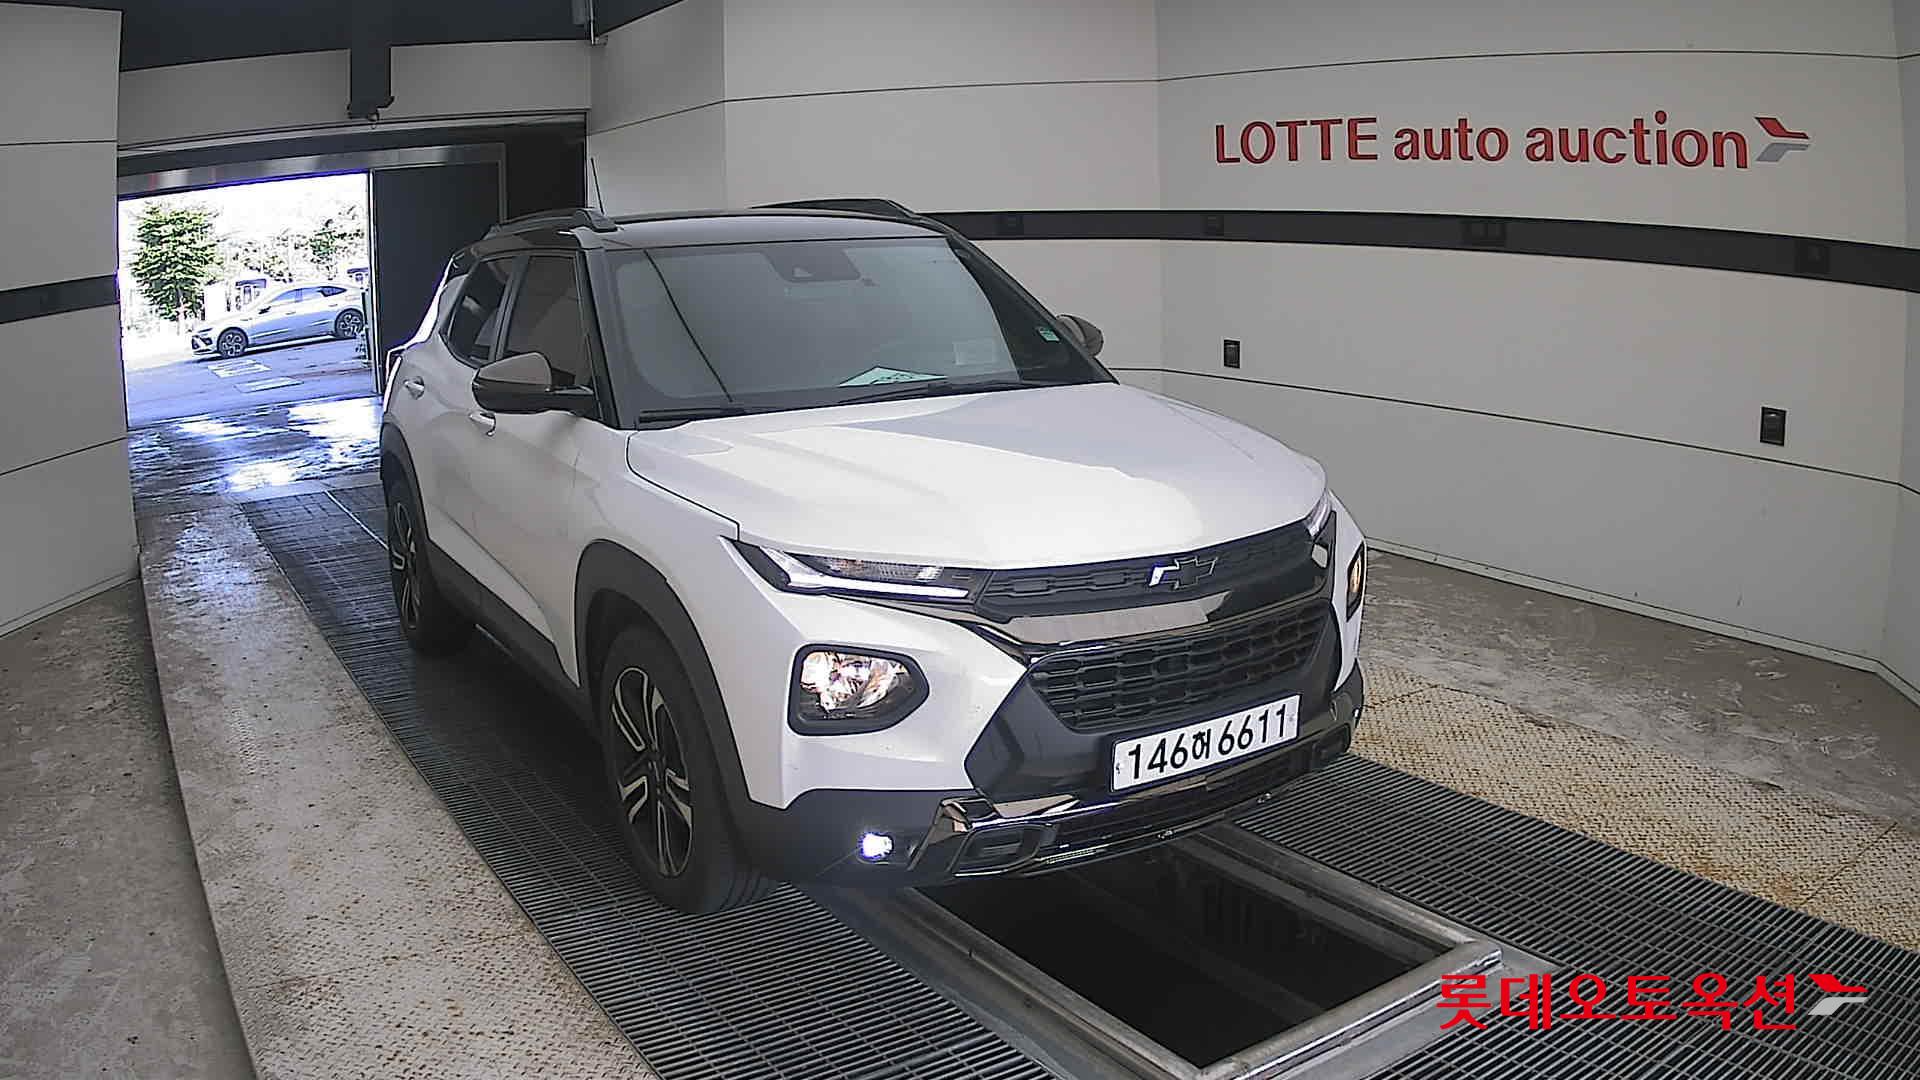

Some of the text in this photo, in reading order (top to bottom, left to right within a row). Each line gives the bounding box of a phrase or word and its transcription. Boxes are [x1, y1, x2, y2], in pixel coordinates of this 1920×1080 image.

[1215, 110, 1749, 169] LOTTE auto auction
